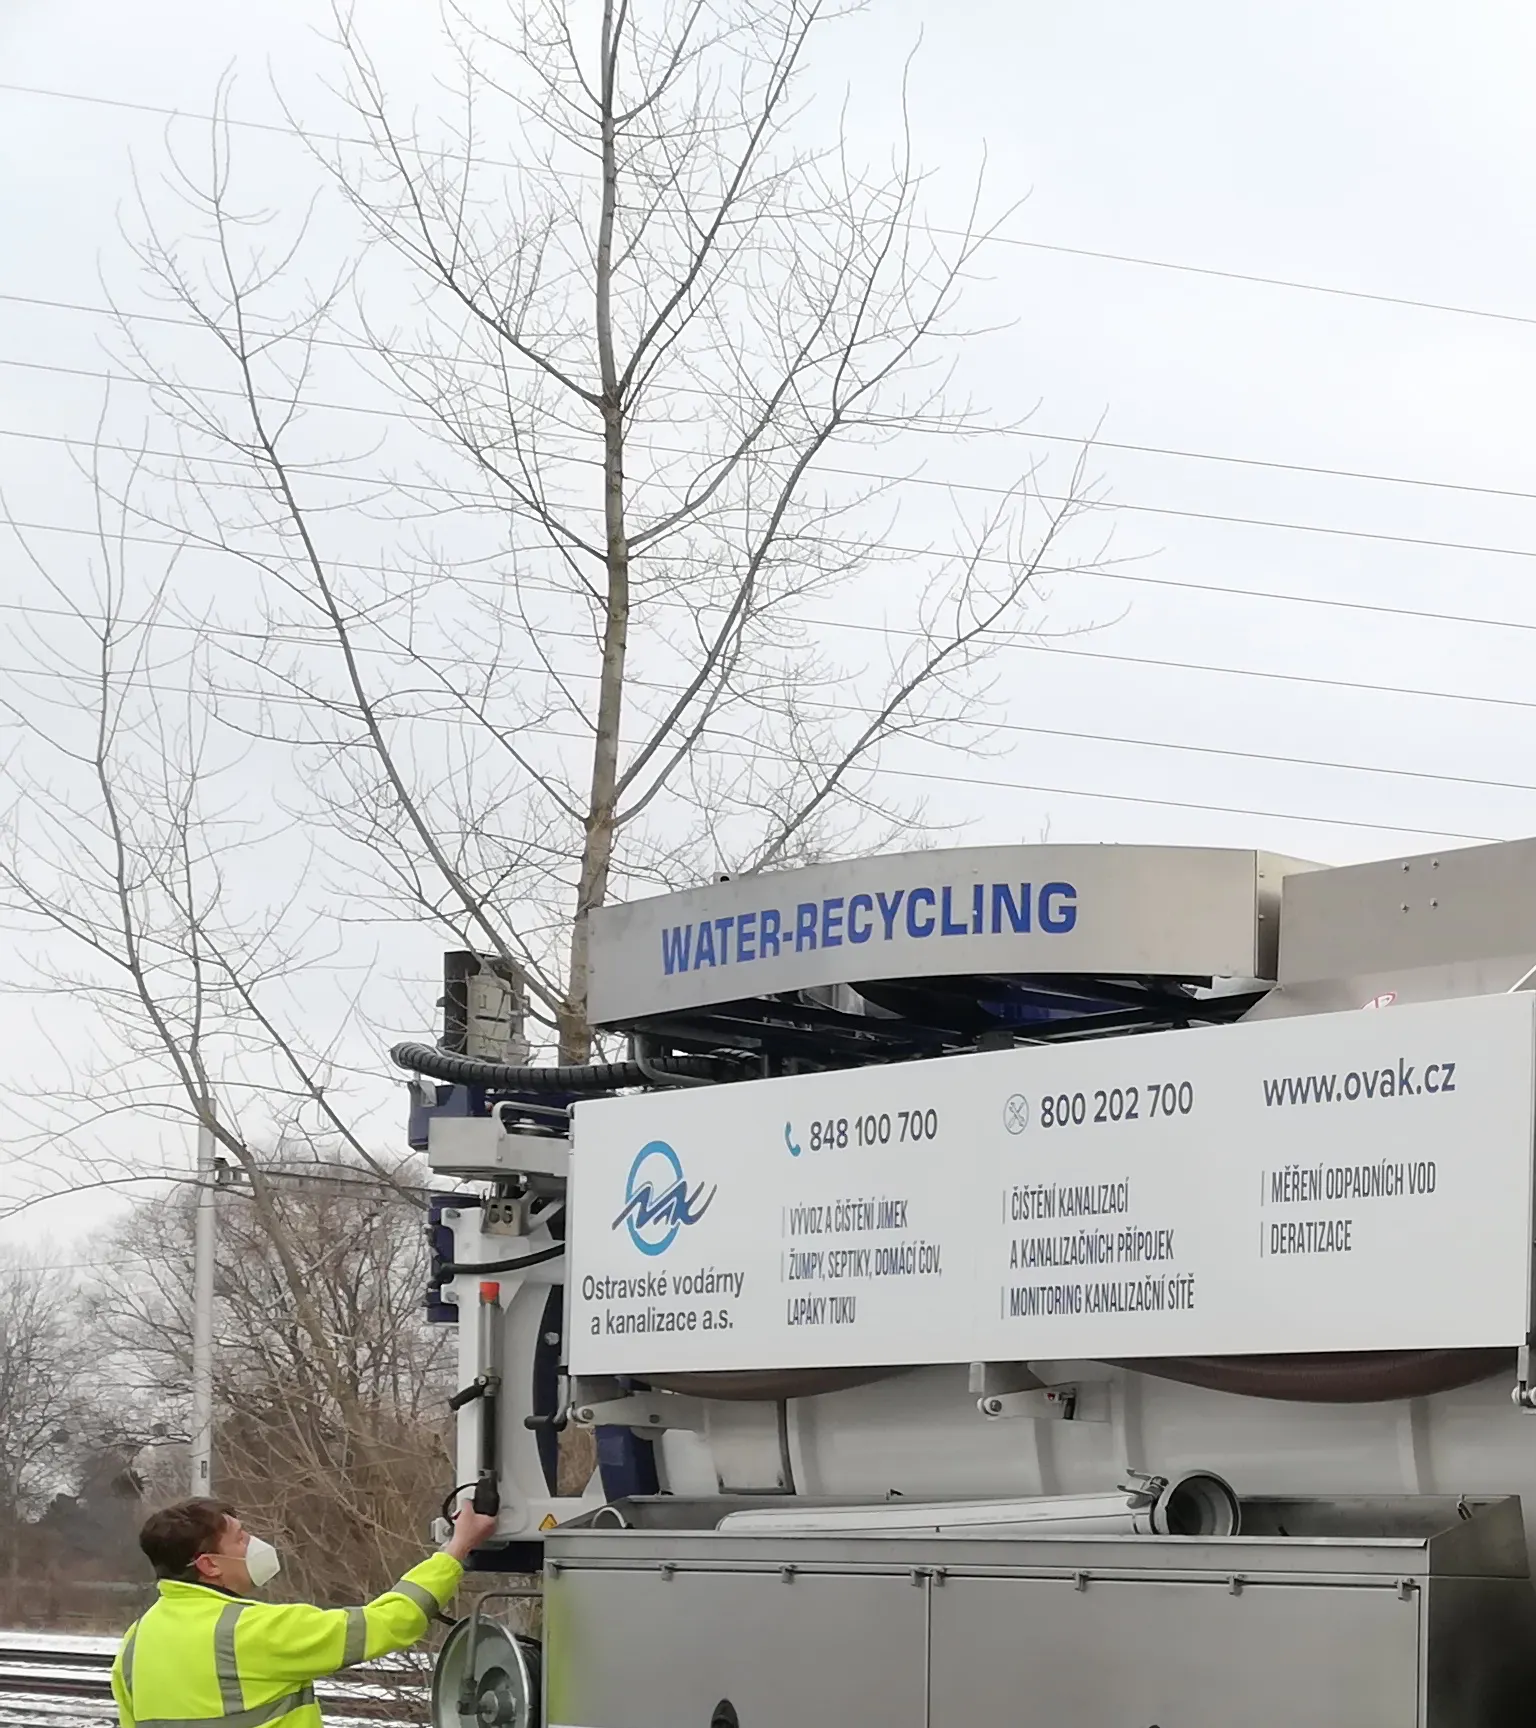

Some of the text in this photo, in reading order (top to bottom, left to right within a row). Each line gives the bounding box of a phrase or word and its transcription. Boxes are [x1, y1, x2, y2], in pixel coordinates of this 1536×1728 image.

[662, 882, 1078, 976] WATER-RECYCLING
[1263, 1057, 1456, 1107] www.ovak.cz
[1040, 1081, 1194, 1129] 800 202 700
[809, 1108, 938, 1152] 848 100 700
[1011, 1175, 1130, 1222] ČIŠTĚNÍ KANALIZACÍ
[1271, 1157, 1437, 1203] MĚŘENÍ ODPADNÍCH VOD
[790, 1195, 909, 1236] VÝVOZ A ČIŠTĚNÍ JÍMEK
[1270, 1219, 1353, 1254] DERATIZACE
[788, 1247, 826, 1282] ŽUMPY,
[828, 1248, 873, 1280] SEPTIKY,
[875, 1240, 918, 1276] DOMÁCÍ
[1010, 1225, 1175, 1270] A KANALIZAČNÍCH PŘÍPOJEK
[581, 1265, 745, 1301] Ostravské vodárny
[1010, 1272, 1195, 1318] MONITORING KANALIZAČNÍ SÍTĚ
[590, 1306, 734, 1335] a kanalizace a.s.
[787, 1291, 857, 1326] LAPÁKY TUKU
